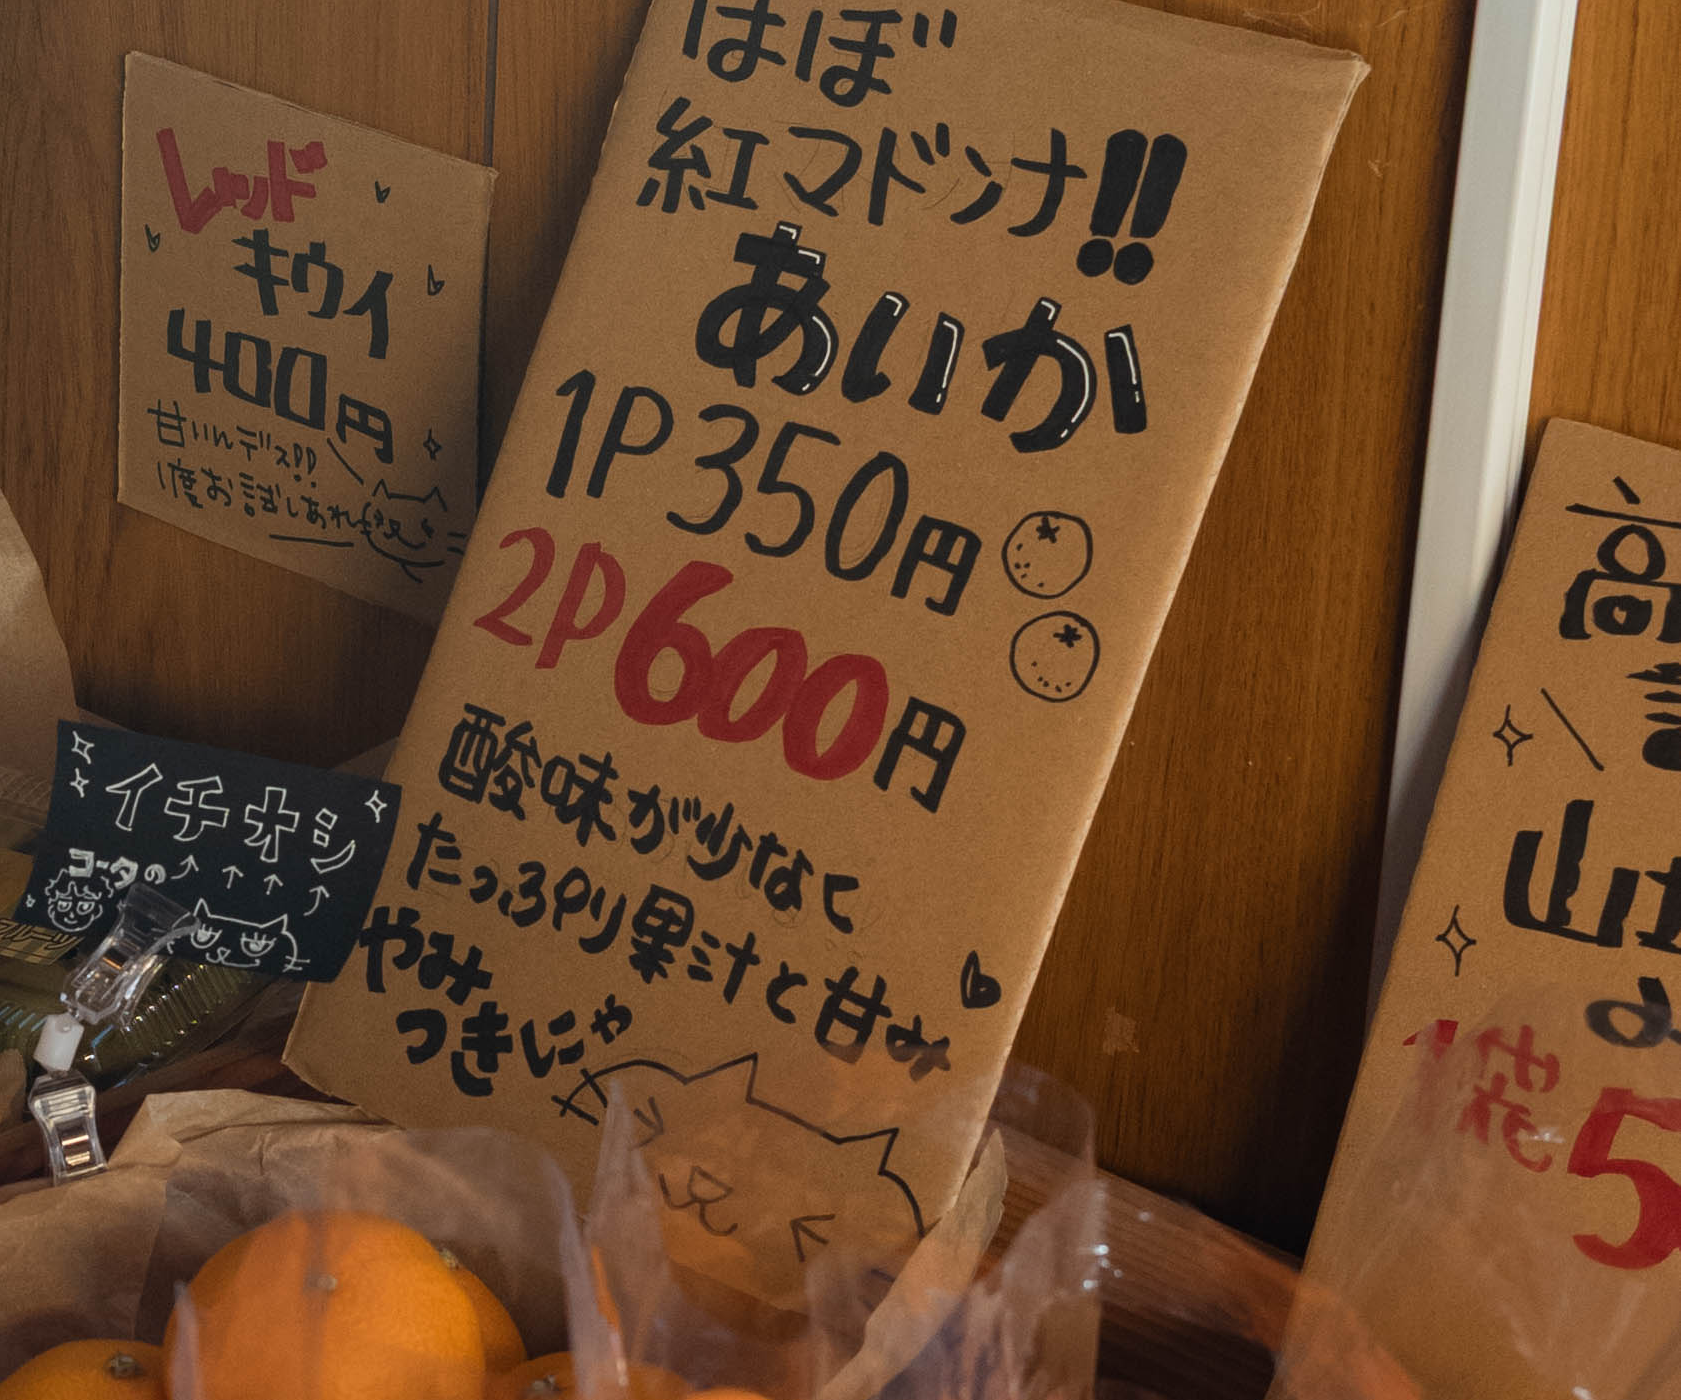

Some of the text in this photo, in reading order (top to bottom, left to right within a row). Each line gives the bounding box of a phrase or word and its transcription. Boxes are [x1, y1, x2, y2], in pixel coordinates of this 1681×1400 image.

[154, 126, 329, 236] レッド
[229, 227, 395, 361] キウイ
[694, 221, 1149, 455] あいか
[166, 306, 395, 465] 400円
[105, 762, 357, 875] イチオシ
[395, 994, 634, 1098] つきにゃ
